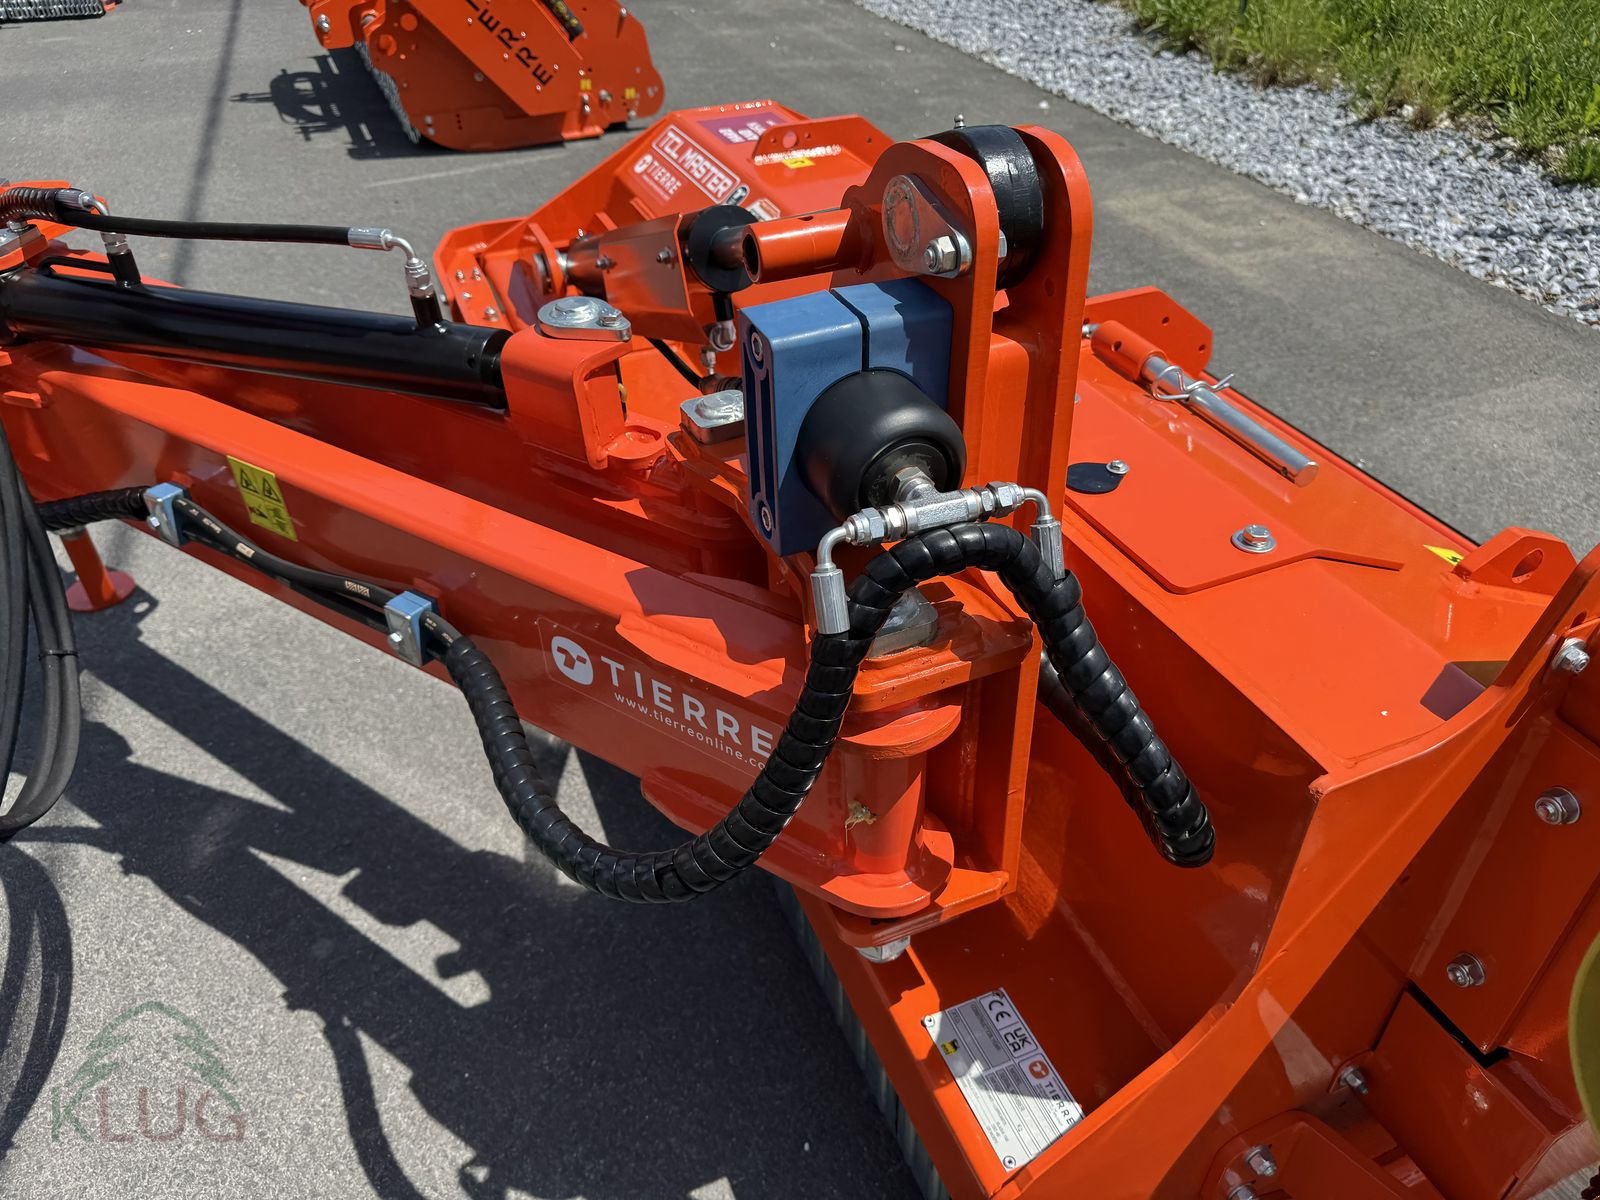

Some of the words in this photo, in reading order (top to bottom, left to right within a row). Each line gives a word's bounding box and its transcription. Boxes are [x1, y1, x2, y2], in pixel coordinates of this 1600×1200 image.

[646, 160, 682, 195] TIERRE
[660, 131, 685, 160] TCL
[679, 146, 734, 198] MASTER
[601, 656, 774, 758] TIERRE
[988, 1000, 1011, 1022] CE
[1013, 1028, 1032, 1048] UK
[1045, 1081, 1075, 1126] TIERRE
